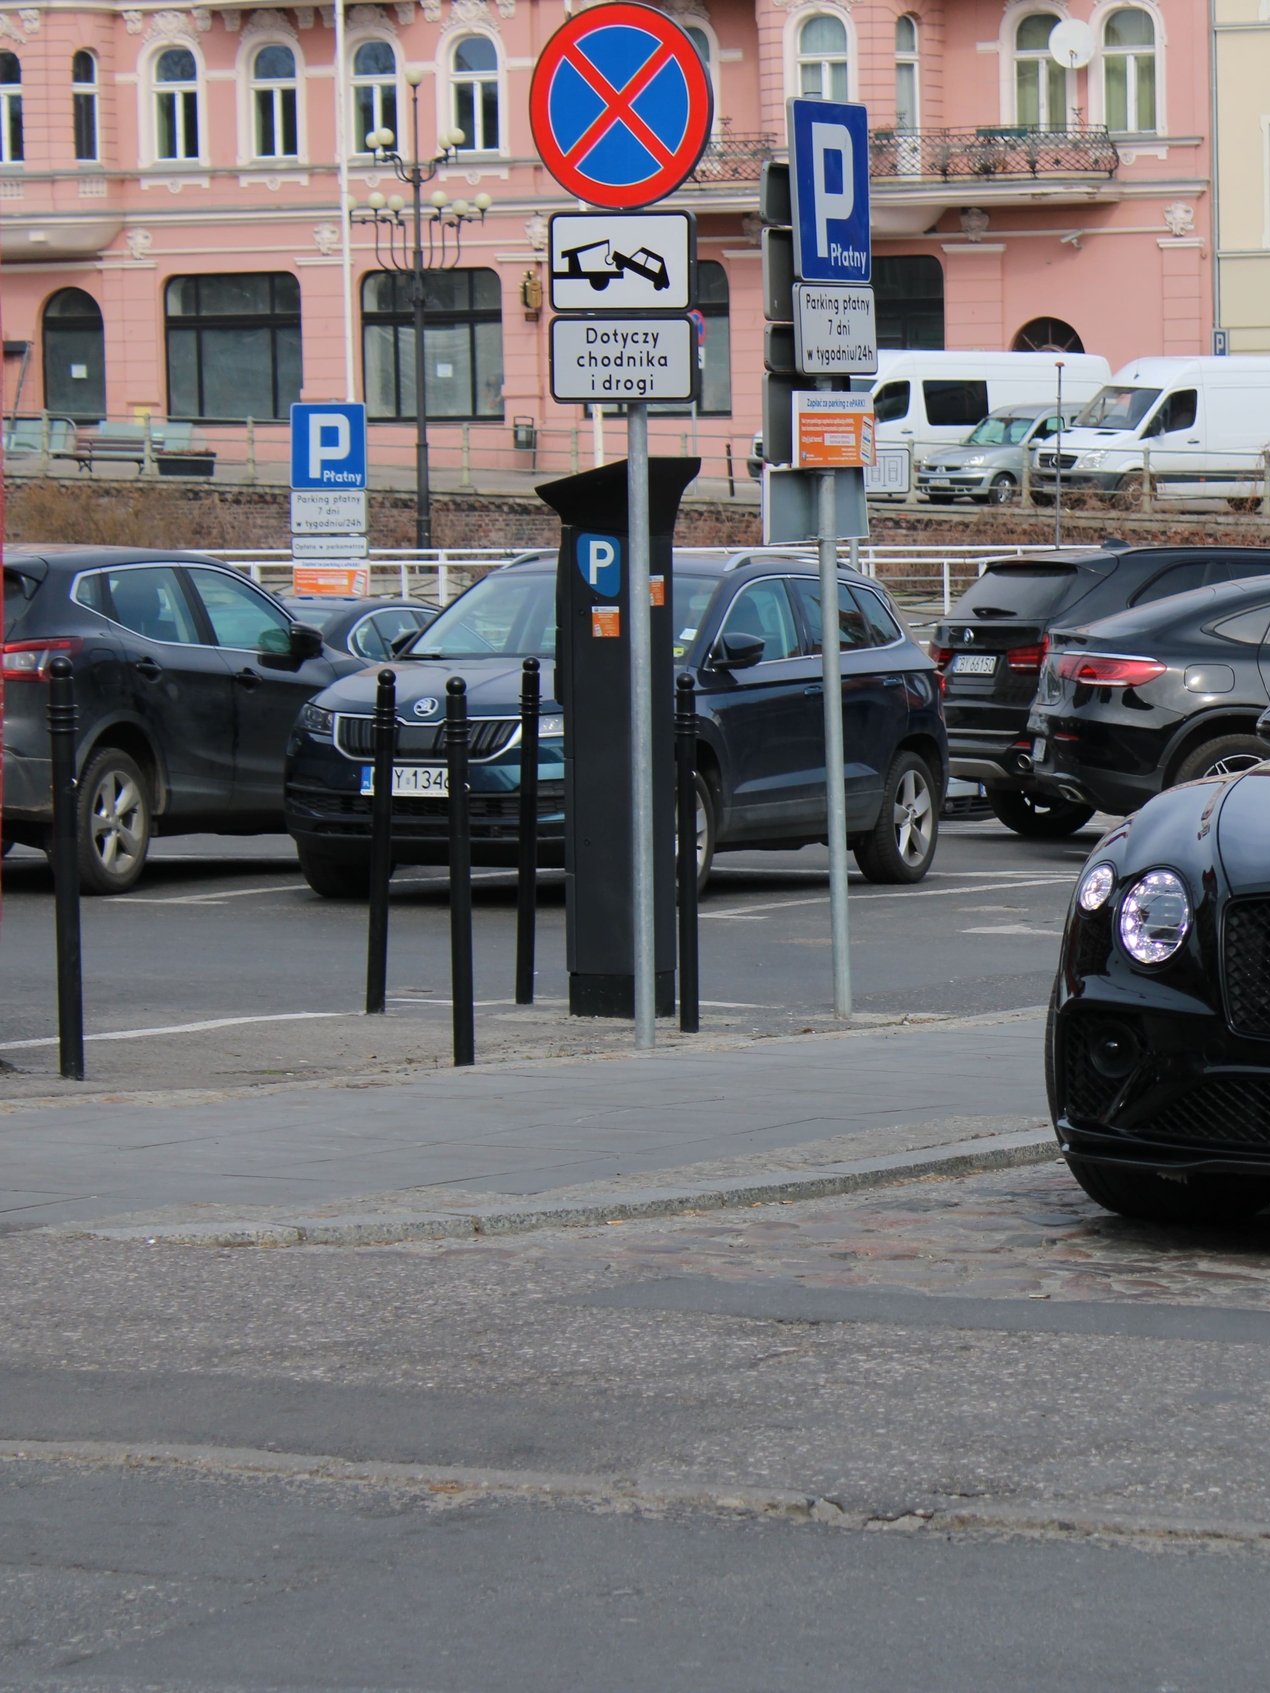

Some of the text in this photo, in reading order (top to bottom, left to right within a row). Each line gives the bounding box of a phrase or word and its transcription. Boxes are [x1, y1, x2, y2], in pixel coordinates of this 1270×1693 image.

[811, 121, 854, 258] P
[830, 243, 867, 275] Płatny
[805, 294, 870, 316] Parking płatny
[828, 319, 851, 336] 7 dni
[586, 327, 659, 349] Dotyczy
[576, 351, 668, 368] chodnika
[807, 347, 873, 365] w tygodniu/24h
[591, 374, 654, 396] i drogi
[309, 414, 351, 478] P
[323, 470, 362, 485] Płatny
[297, 495, 361, 506] Parking płatny
[318, 507, 340, 515] 7 dni
[305, 519, 362, 529] tygodniu/24h
[589, 541, 615, 585] P
